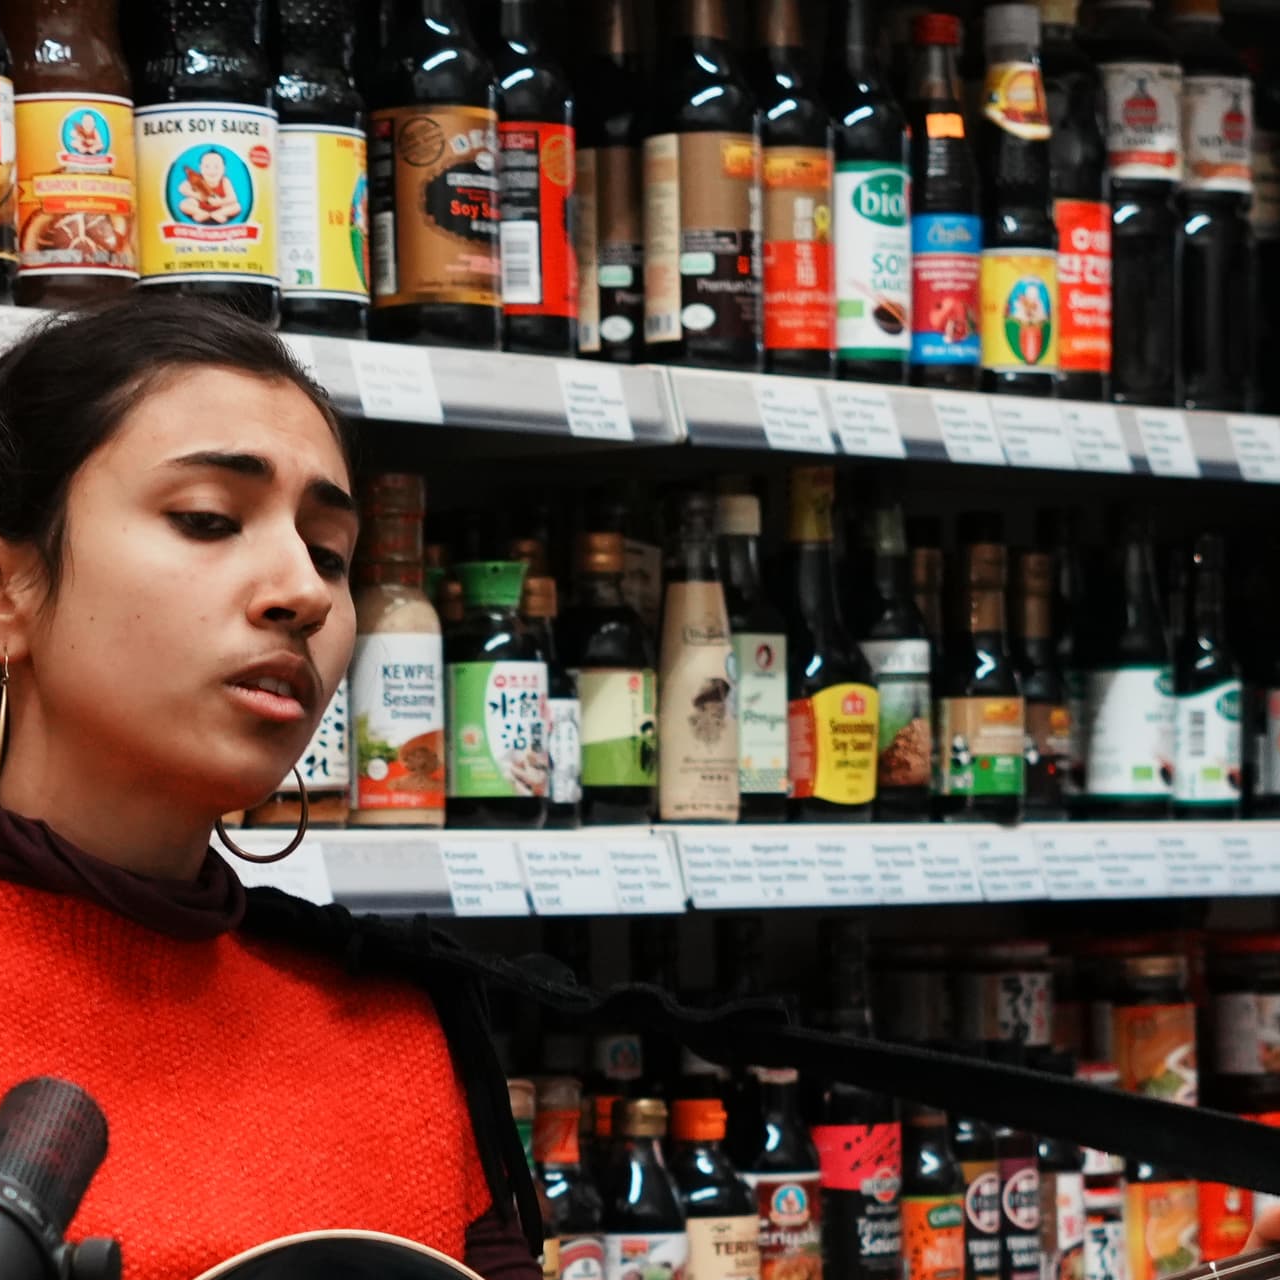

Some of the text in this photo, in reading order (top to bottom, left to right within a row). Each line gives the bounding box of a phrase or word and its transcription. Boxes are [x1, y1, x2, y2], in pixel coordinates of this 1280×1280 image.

[143, 119, 261, 136] BLACK SOY SAUCE
[449, 199, 477, 217] Soy
[382, 664, 435, 680] KEWPIE
